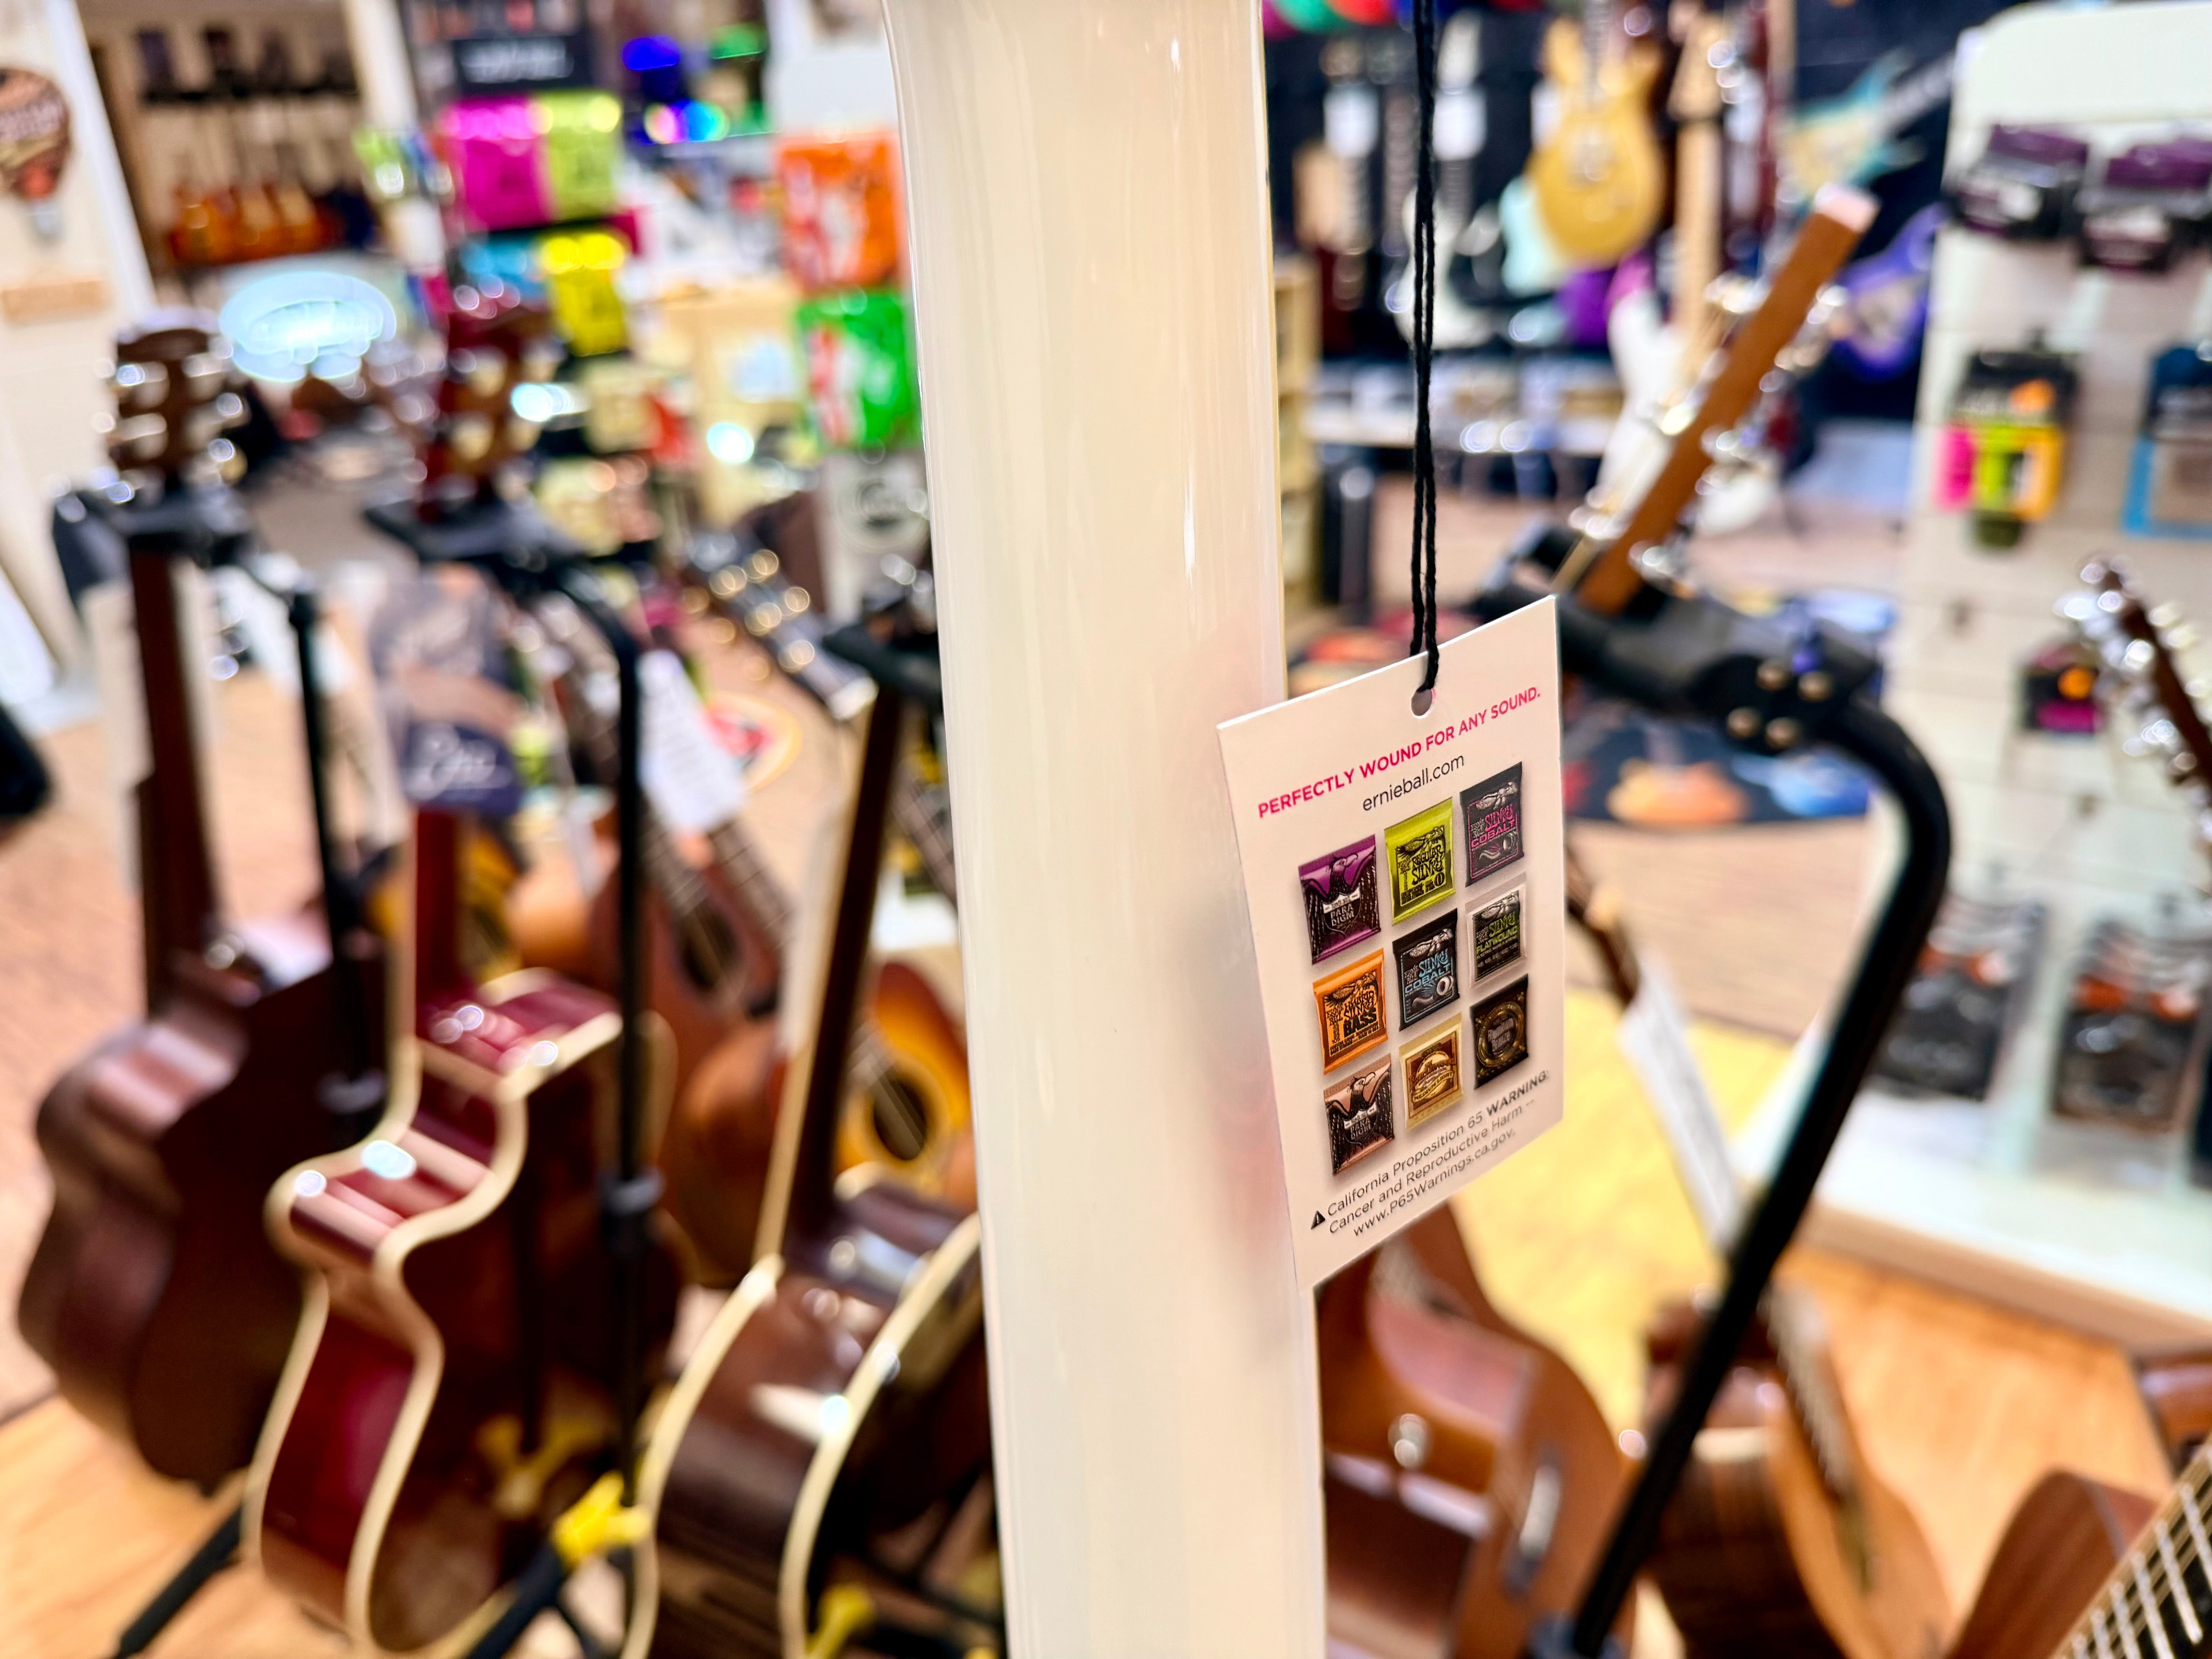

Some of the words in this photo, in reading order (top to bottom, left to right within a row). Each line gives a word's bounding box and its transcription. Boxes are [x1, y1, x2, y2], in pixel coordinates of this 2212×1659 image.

[1259, 769, 1354, 818] PERFECTLY
[1359, 741, 1422, 779] WOUND
[1425, 725, 1455, 752] FOR
[1458, 709, 1487, 736] ANY
[1491, 686, 1541, 719] SOUND.
[1362, 754, 1465, 812] ernieball.com
[1472, 819, 1515, 848] COBALT
[1330, 903, 1353, 919] PARA
[1331, 910, 1354, 927] DIGM
[1476, 925, 1517, 955] FLATWOUND
[1419, 948, 1448, 977] SLINKY
[1405, 963, 1451, 994] COBALT
[1343, 1006, 1377, 1038] BASS
[1328, 1173, 1389, 1217] California
[1393, 1125, 1464, 1176] Proposition
[1468, 1110, 1483, 1130] 65
[1329, 1199, 1374, 1234] Cancer
[1379, 1179, 1402, 1204] and
[1407, 1128, 1488, 1187] Reproductive
[1492, 1104, 1523, 1131] Harm
[1353, 1128, 1516, 1237] www.P65Warnings.ca.gov.
